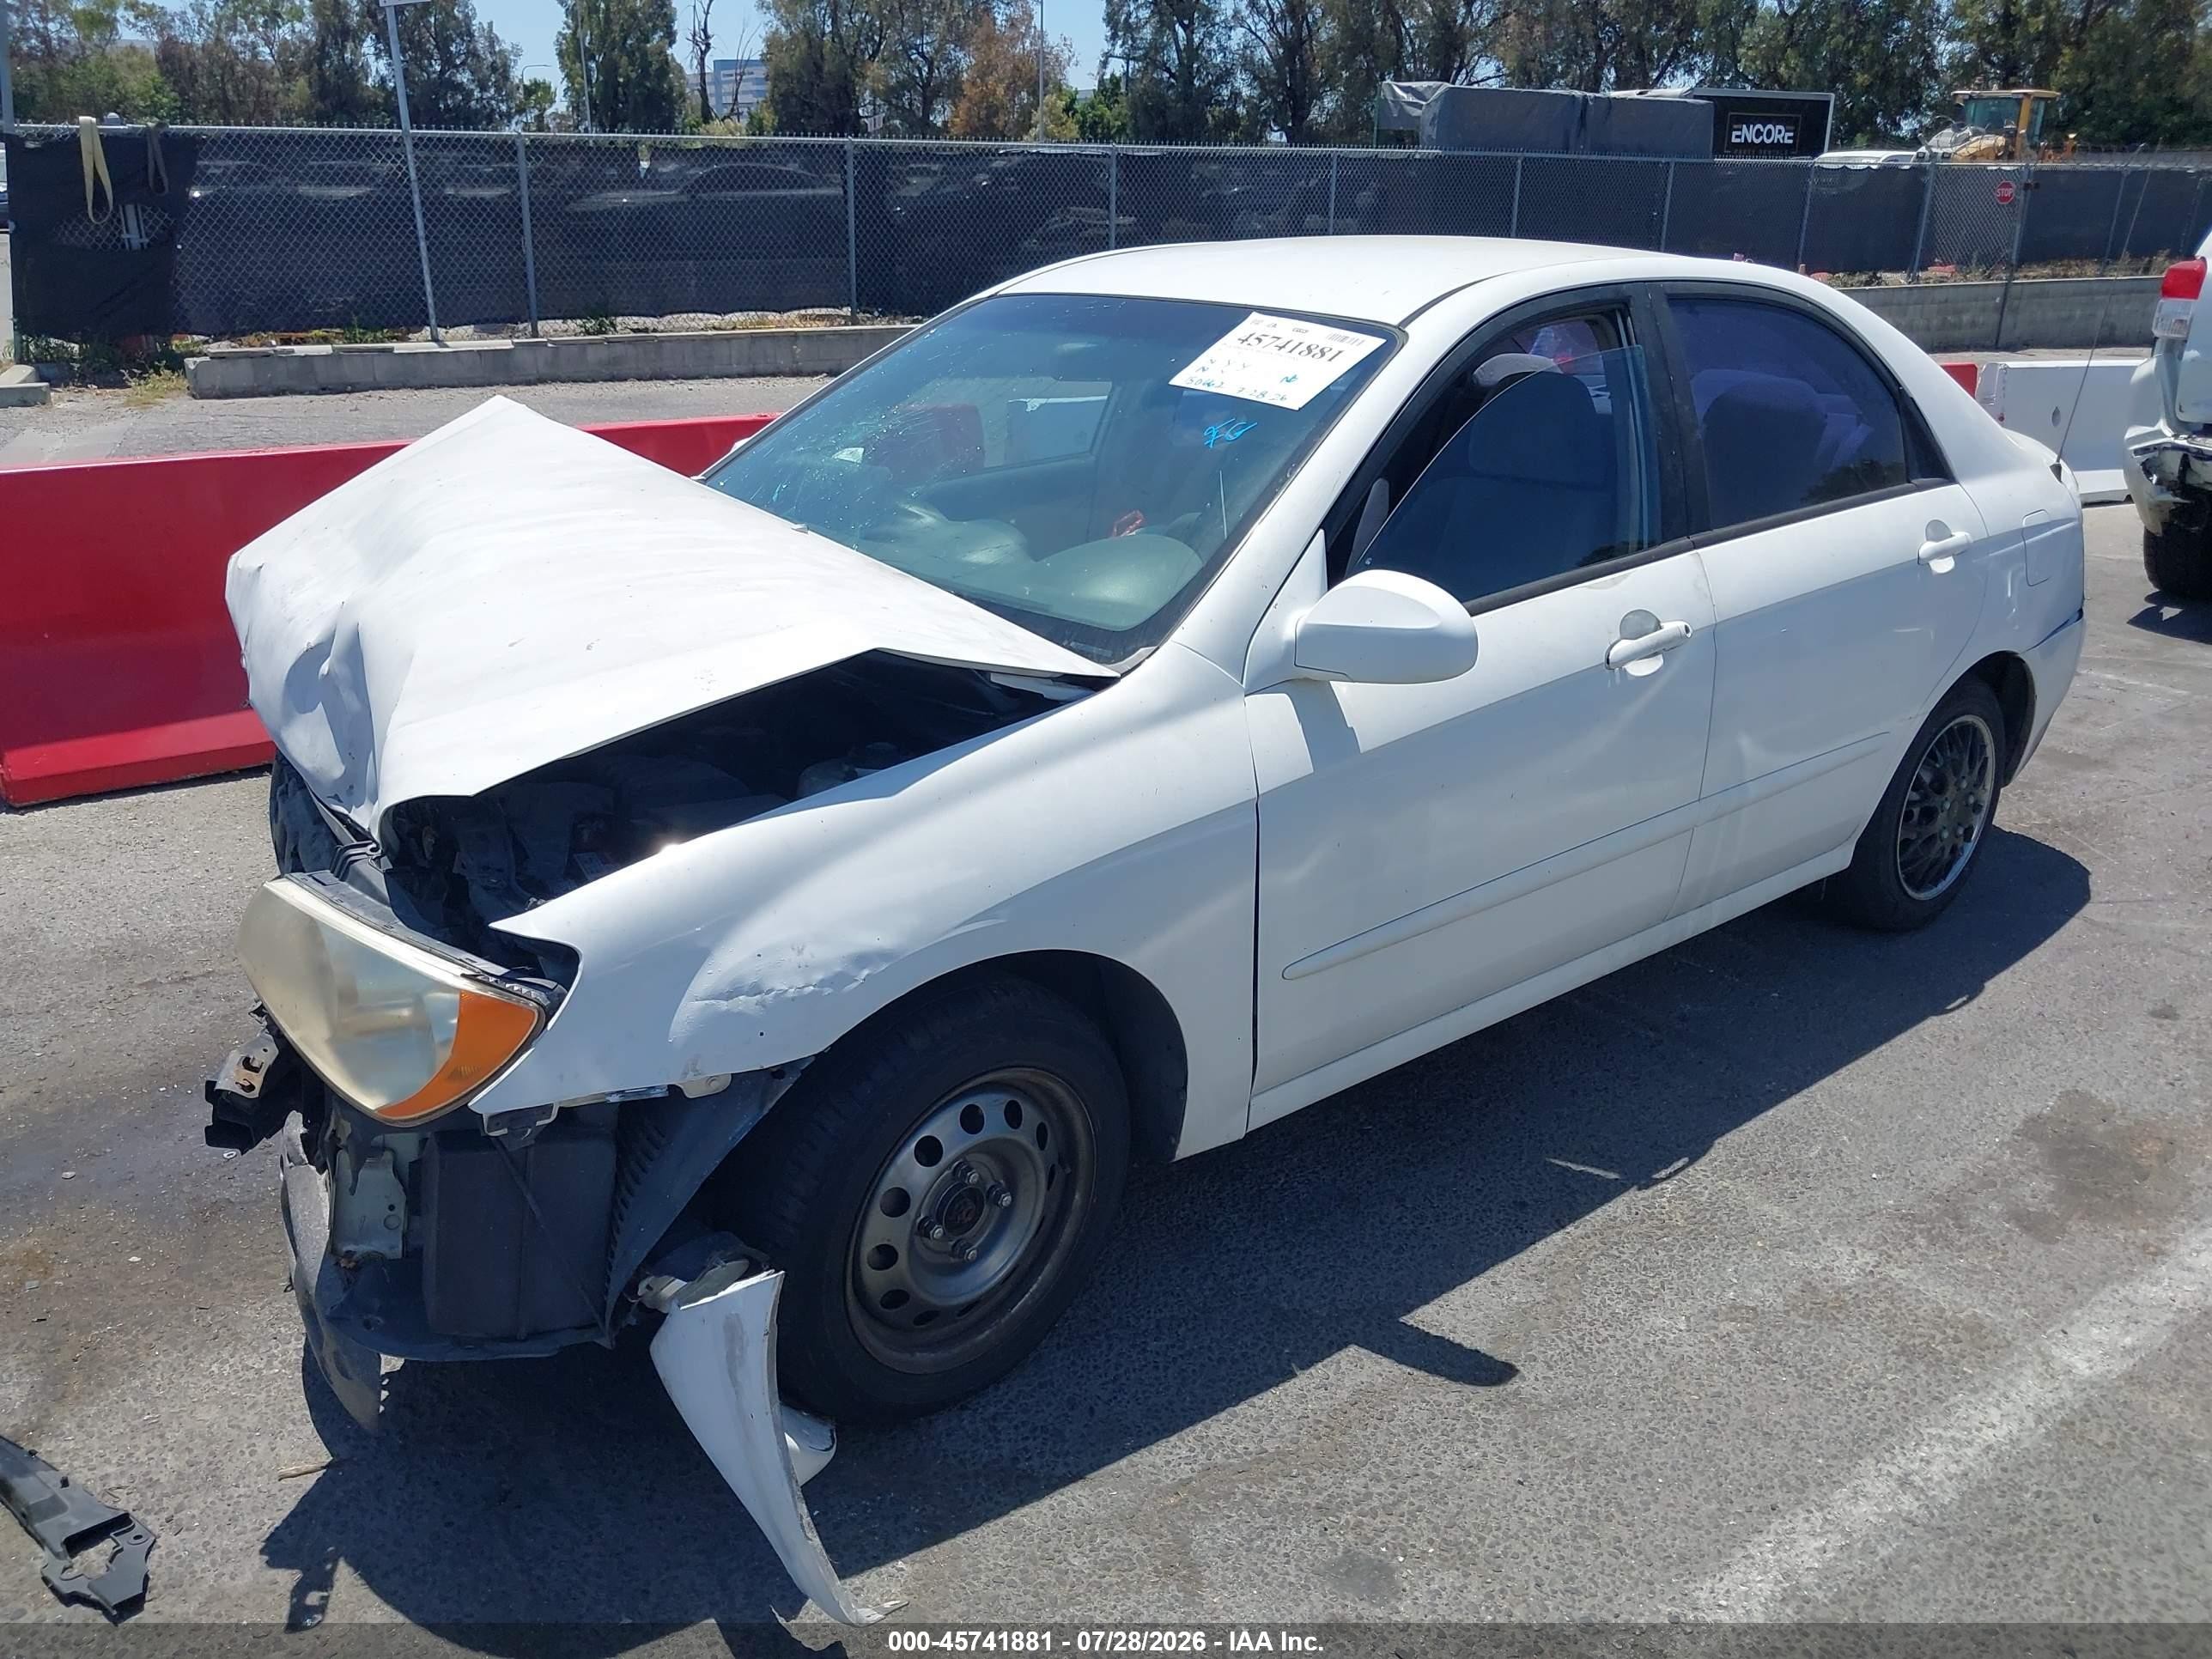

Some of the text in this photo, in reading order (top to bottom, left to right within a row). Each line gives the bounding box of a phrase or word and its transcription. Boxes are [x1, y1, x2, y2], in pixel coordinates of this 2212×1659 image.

[1731, 124, 1795, 144] ENCORE
[1996, 188, 2014, 198] STOP
[1237, 331, 1345, 362] 45741881
